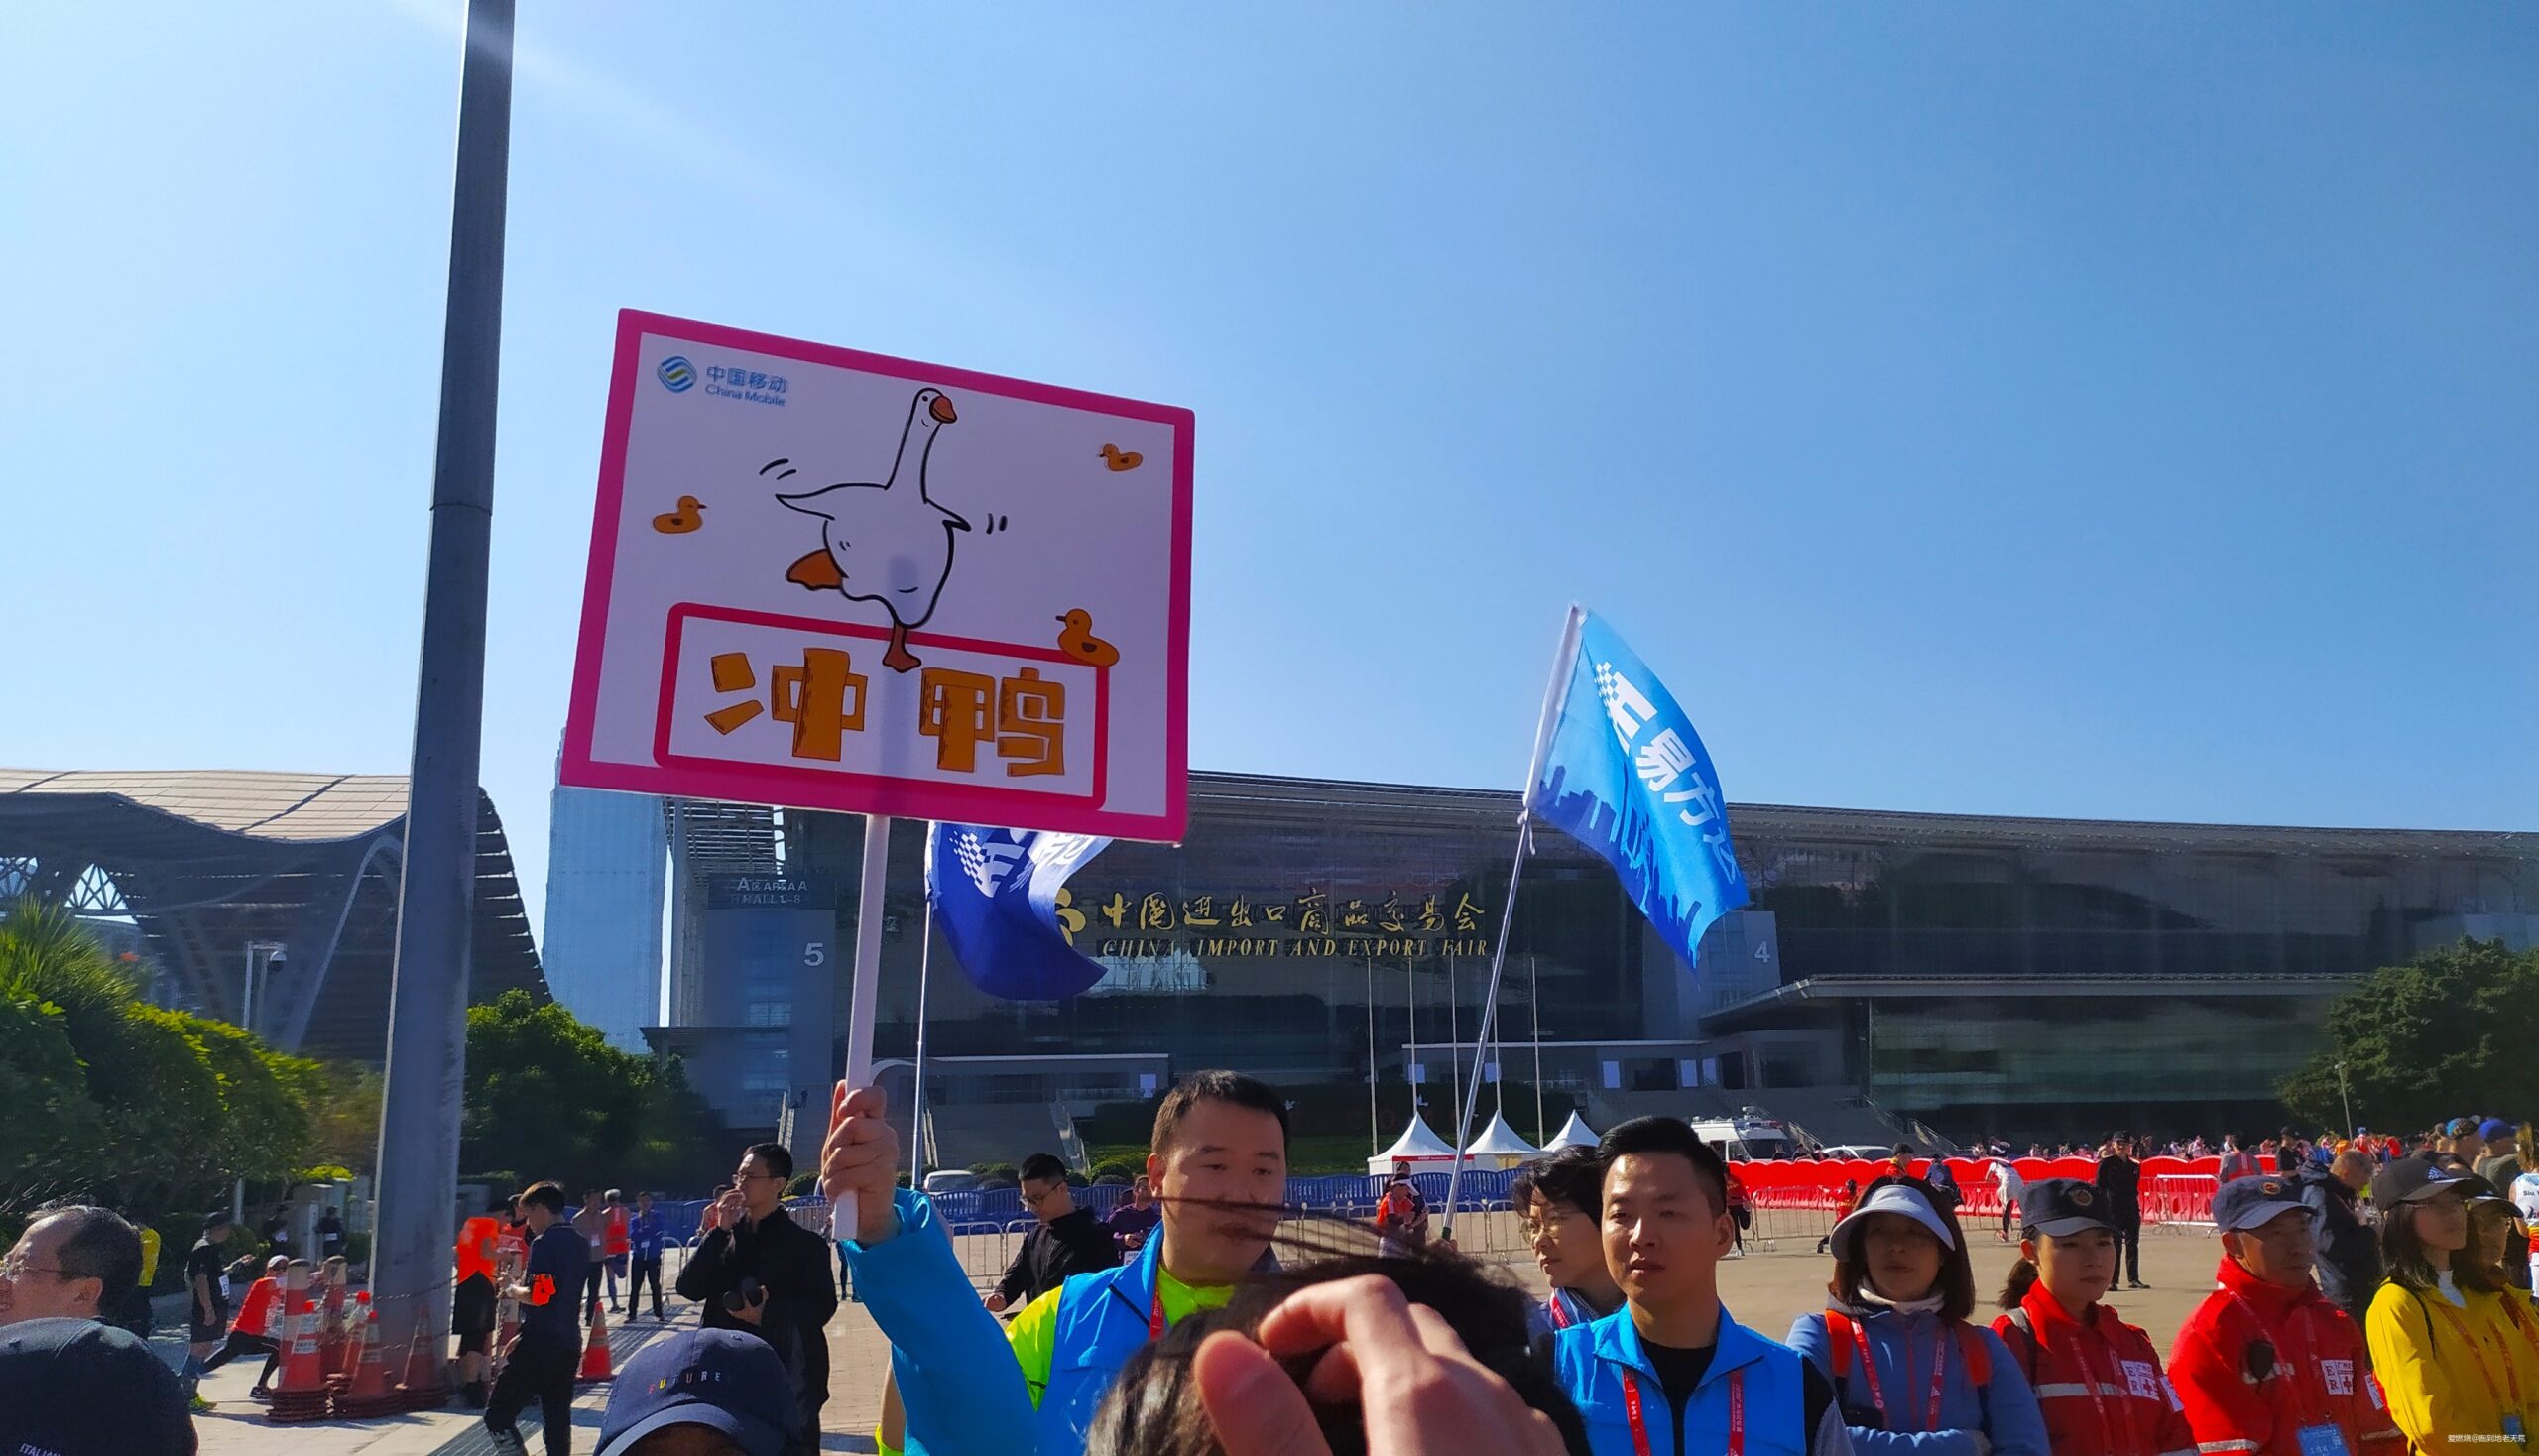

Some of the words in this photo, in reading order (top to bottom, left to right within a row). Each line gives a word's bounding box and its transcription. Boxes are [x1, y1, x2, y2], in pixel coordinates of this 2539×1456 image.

[705, 383, 743, 400] China
[706, 365, 788, 394] 中国移动
[704, 648, 1066, 778] 冲鸭
[803, 942, 825, 967] 5
[1102, 939, 1177, 957] CHINA
[1197, 939, 1279, 957] IMPORT
[1290, 939, 1337, 957] AND
[1348, 939, 1427, 957] EXPORT
[1442, 939, 1488, 957] FAIR
[1753, 941, 1770, 963] 4
[647, 1371, 722, 1395] FUTURE
